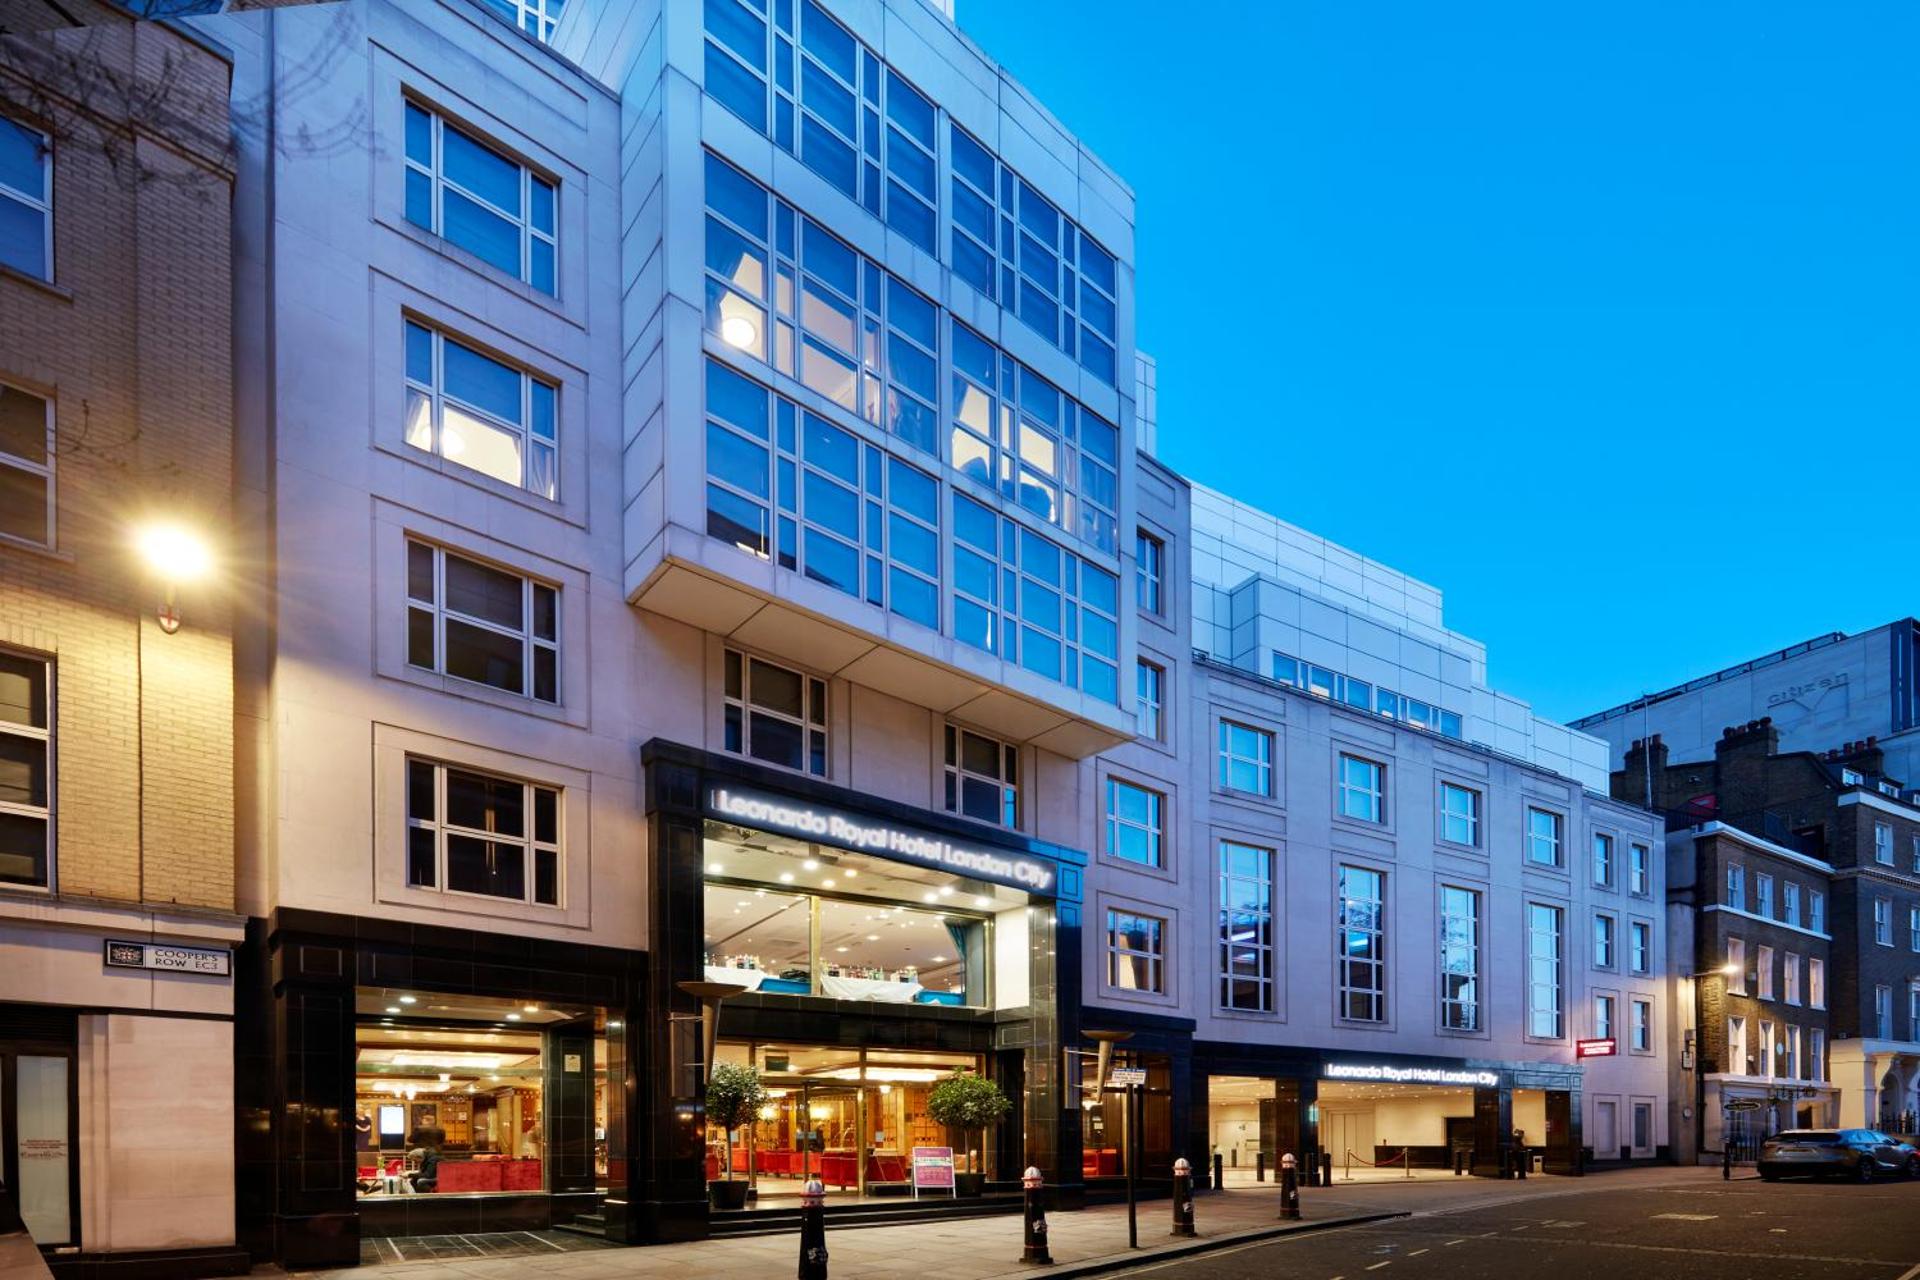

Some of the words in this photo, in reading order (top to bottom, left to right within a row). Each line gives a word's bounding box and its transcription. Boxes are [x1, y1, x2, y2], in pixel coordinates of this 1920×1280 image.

[718, 790, 827, 834] Leonardo
[829, 815, 888, 848] Royal
[890, 831, 941, 861] Hotel
[944, 844, 1012, 878] London
[1014, 861, 1051, 890] City
[155, 949, 218, 962] COOPER'S
[155, 959, 187, 968] ROW
[195, 962, 218, 970] EC3
[1328, 1064, 1382, 1079] Leonardo
[1383, 1066, 1412, 1081] Royal
[1413, 1067, 1441, 1082] Hotel
[1442, 1069, 1478, 1083] London
[1478, 1071, 1498, 1086] City
